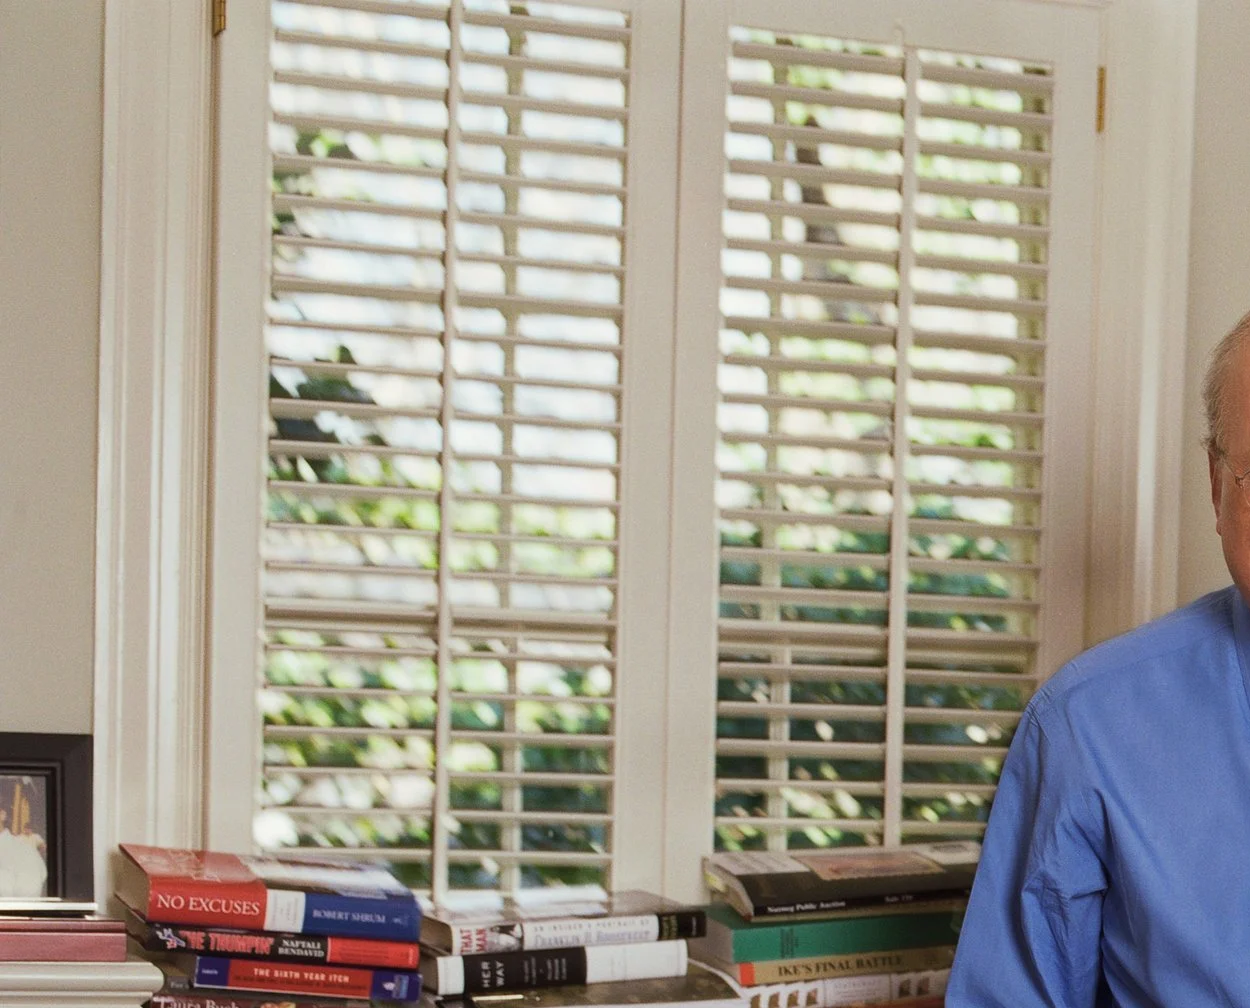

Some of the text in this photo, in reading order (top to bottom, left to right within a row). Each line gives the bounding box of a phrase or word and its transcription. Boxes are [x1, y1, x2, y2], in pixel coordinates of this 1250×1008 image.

[157, 895, 260, 915] NO EXCUSES
[313, 909, 386, 923] ROBERT SHRUM
[282, 939, 321, 949] NAFTALI
[460, 928, 472, 954] THAT
[476, 928, 487, 952] MAN
[278, 947, 324, 958] BENDAVID
[254, 968, 349, 983] THE SIXTH YEAR ITCH
[482, 961, 490, 988] HER
[496, 961, 504, 986] WAY
